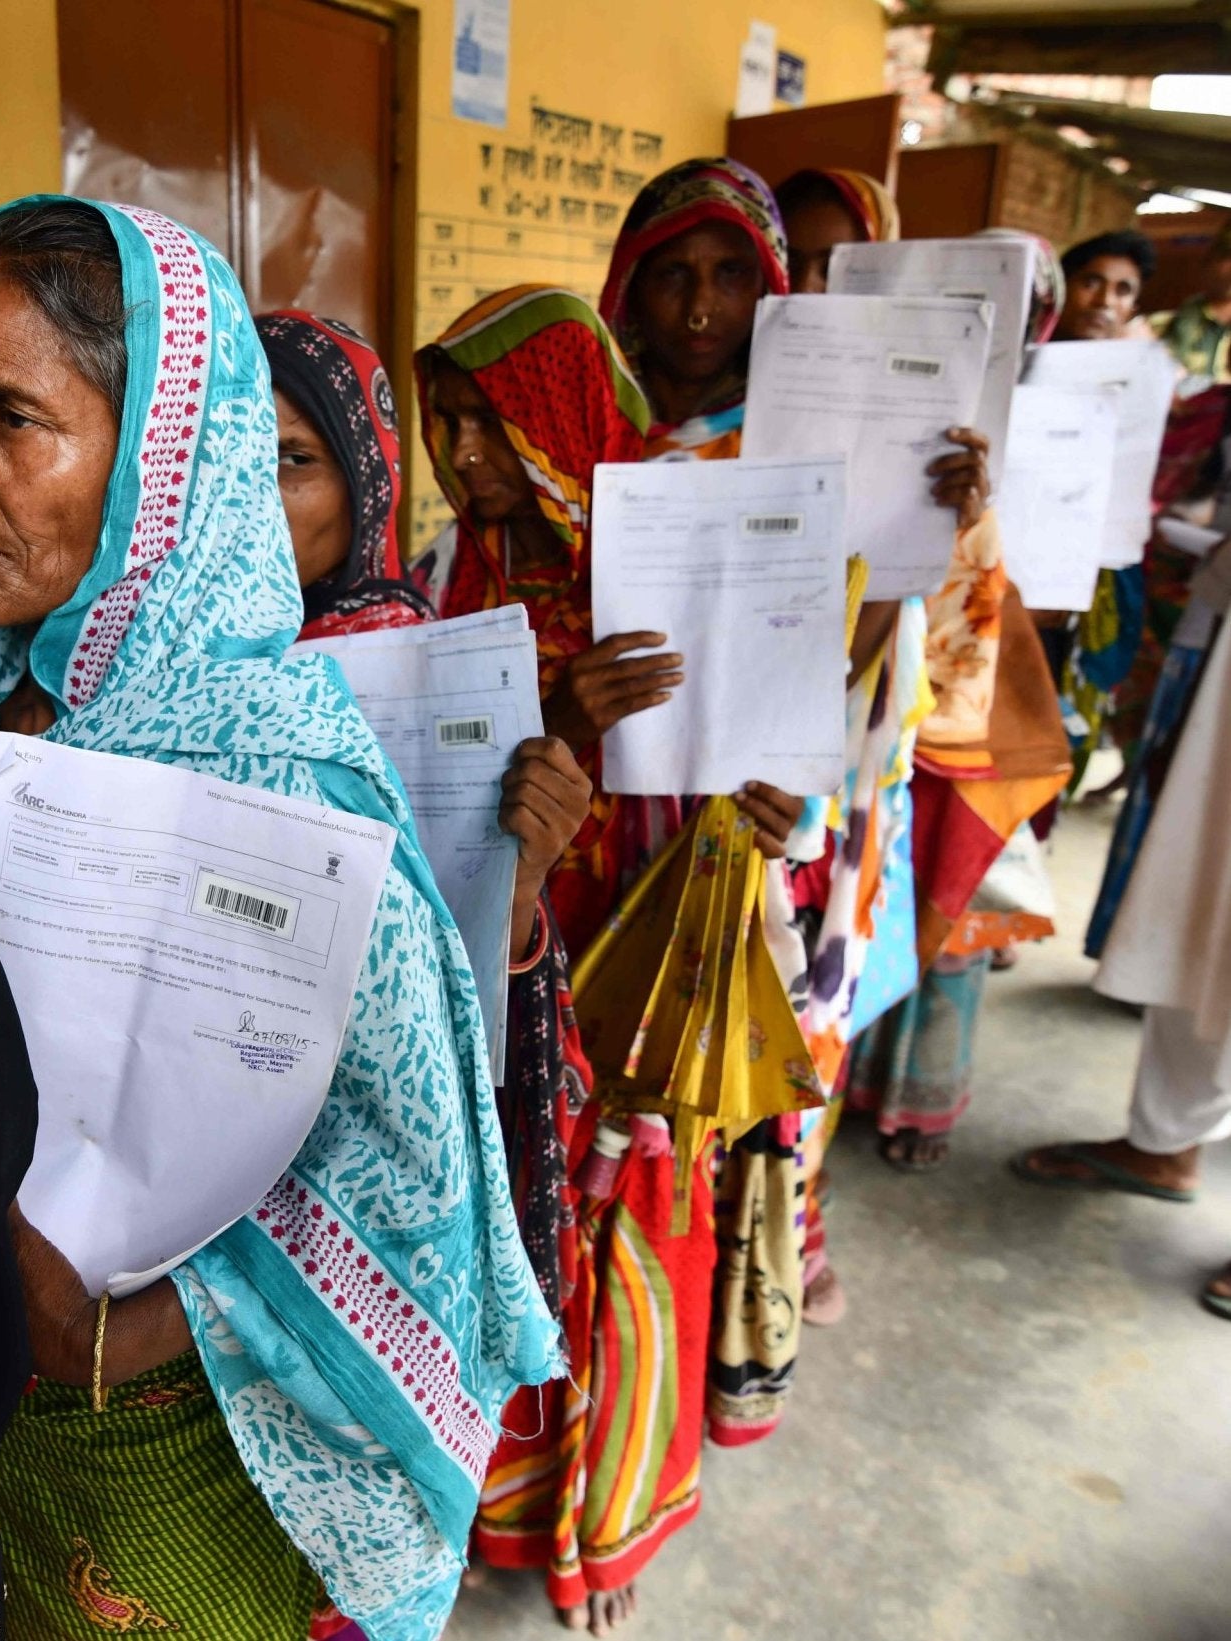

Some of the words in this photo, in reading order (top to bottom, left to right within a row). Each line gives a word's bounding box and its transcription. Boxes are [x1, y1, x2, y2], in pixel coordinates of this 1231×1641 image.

[21, 793, 45, 810] NRC
[45, 804, 62, 814] SEVA
[62, 808, 87, 820] KENDRA
[265, 1066, 285, 1074] Assam
